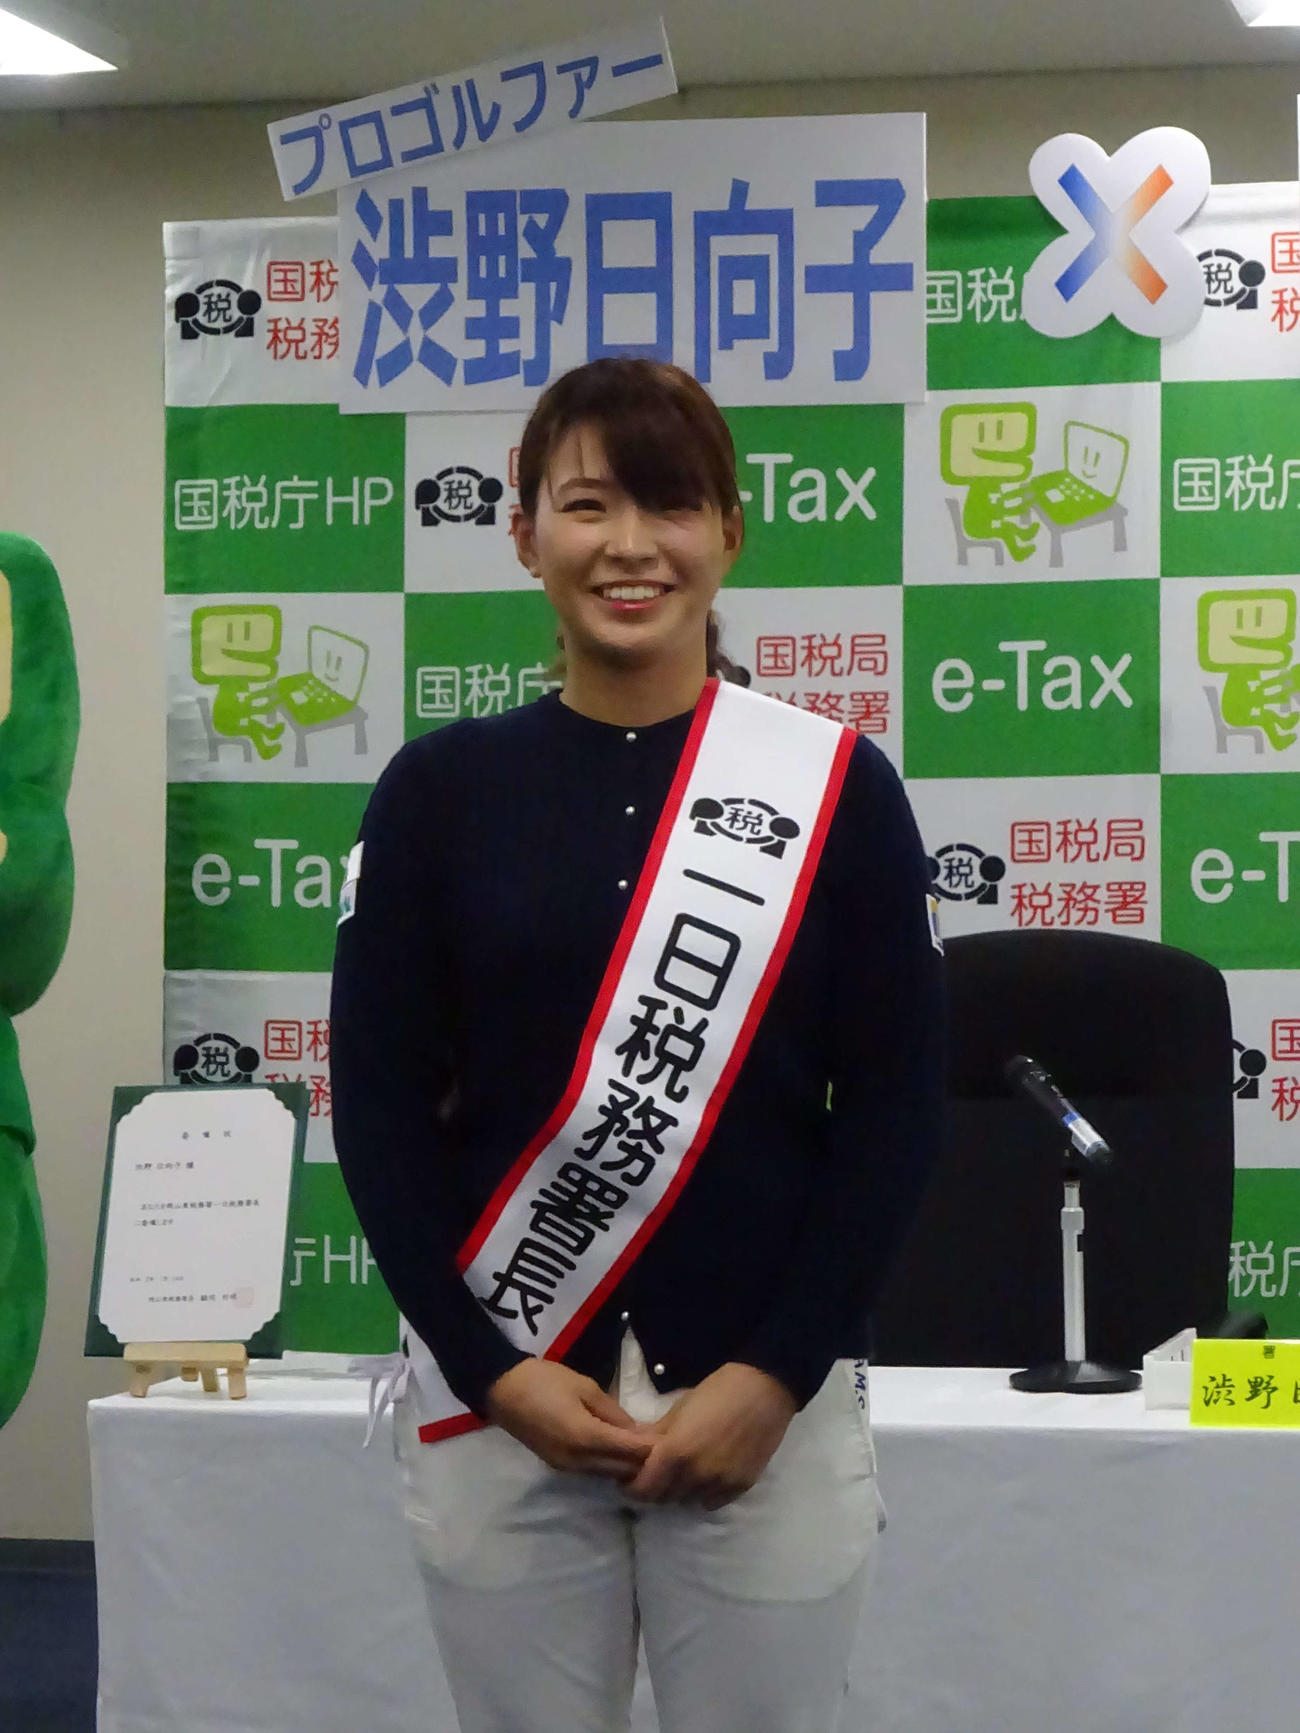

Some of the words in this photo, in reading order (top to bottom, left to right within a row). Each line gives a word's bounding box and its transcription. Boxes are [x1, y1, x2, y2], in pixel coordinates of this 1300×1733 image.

[280, 53, 664, 196] プロゴルファー
[352, 178, 914, 388] 渋野日向子
[926, 266, 1024, 323] 国税
[1203, 262, 1234, 295] 税
[203, 292, 232, 323] 税
[174, 474, 395, 531] 国税庁HP
[442, 478, 474, 511] 税
[756, 632, 889, 678] 国税局
[932, 639, 1133, 713] e-Tax
[764, 690, 890, 734] 務署
[725, 806, 764, 836] 税
[1011, 817, 1146, 864] 国税局
[191, 838, 349, 909] e-Ta
[943, 856, 975, 889] 税
[1190, 831, 1300, 904] e-T
[1010, 880, 1148, 928] 税務署
[200, 1046, 232, 1079] 税
[477, 868, 766, 1336] 一日税務署長
